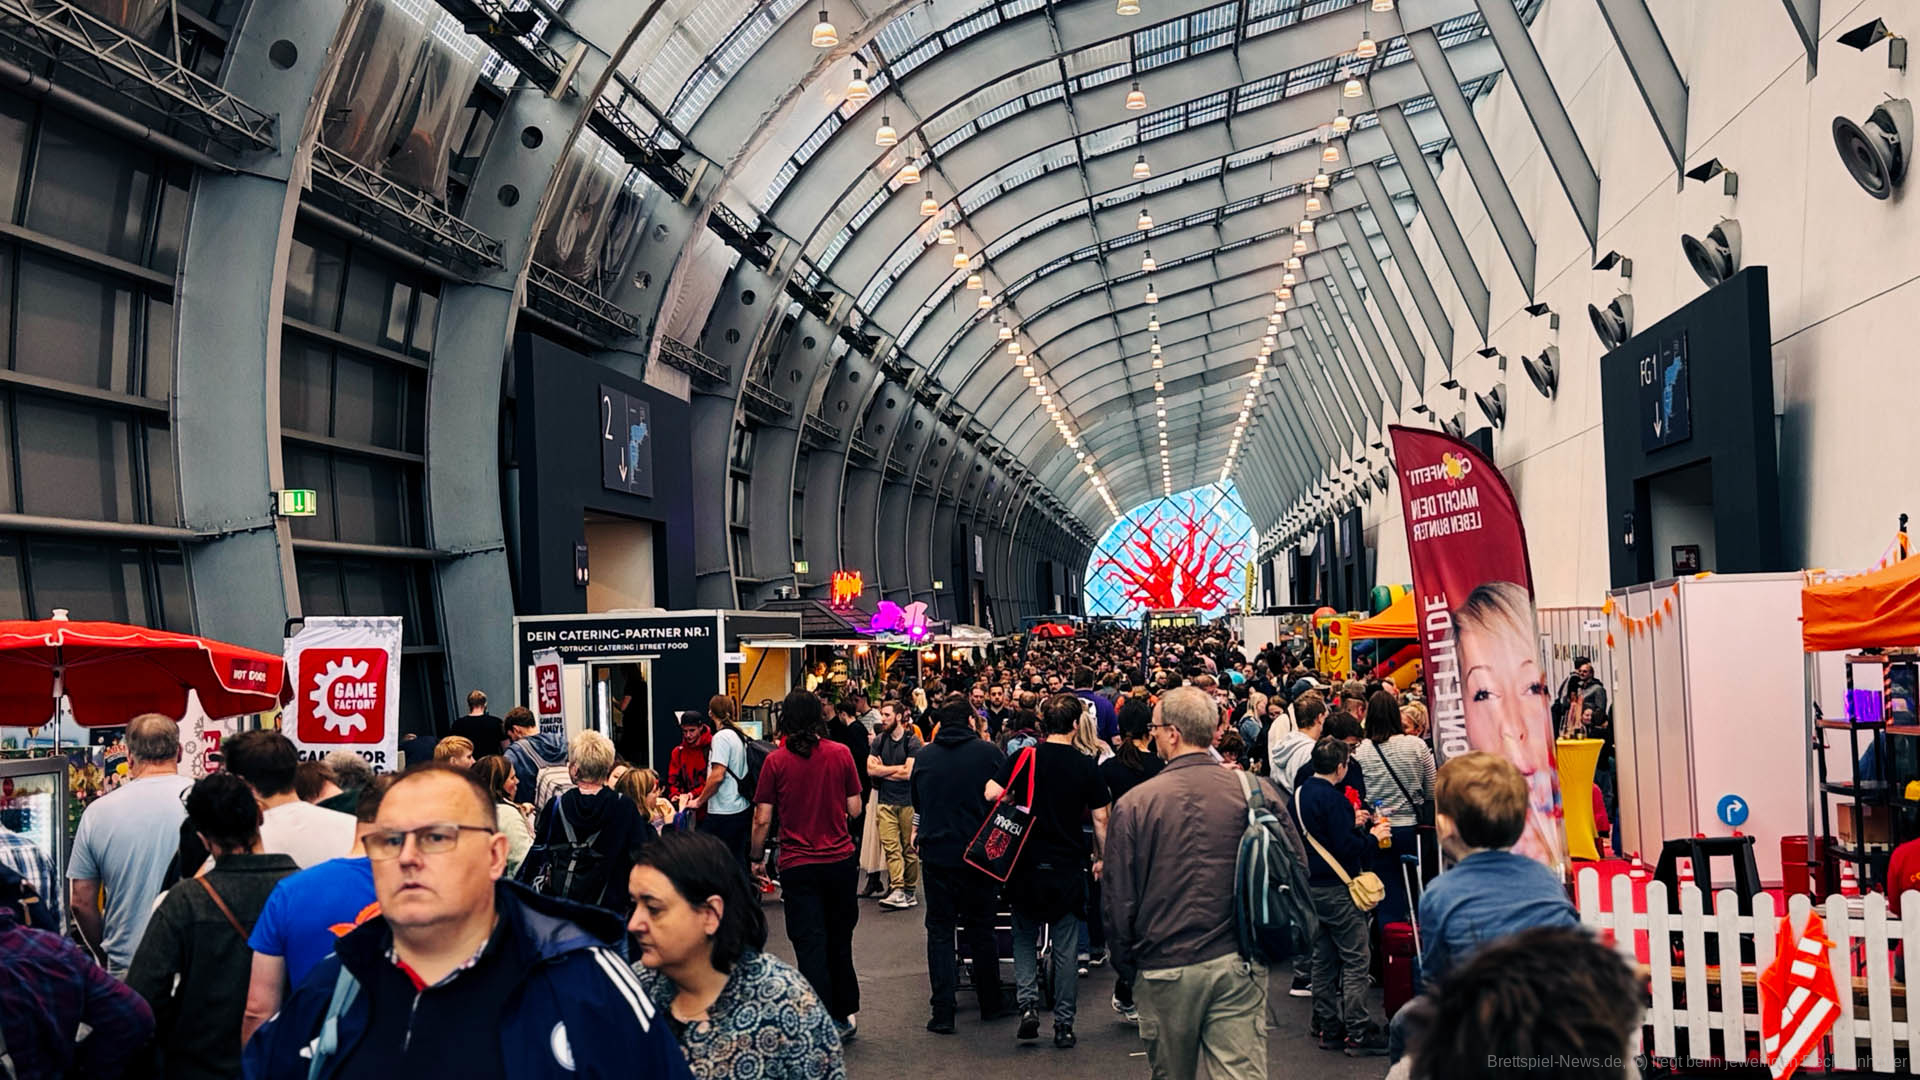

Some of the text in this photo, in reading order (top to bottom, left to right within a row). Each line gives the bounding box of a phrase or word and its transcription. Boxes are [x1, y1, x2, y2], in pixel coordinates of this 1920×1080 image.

[603, 395, 614, 440] 2
[527, 626, 710, 642] DEIN CATERING-PARTNER NR.1
[598, 643, 634, 651] CATERING
[639, 642, 666, 650] STREET
[667, 642, 689, 650] FOOD
[334, 682, 377, 699] GAME
[334, 699, 377, 710] FACTORY
